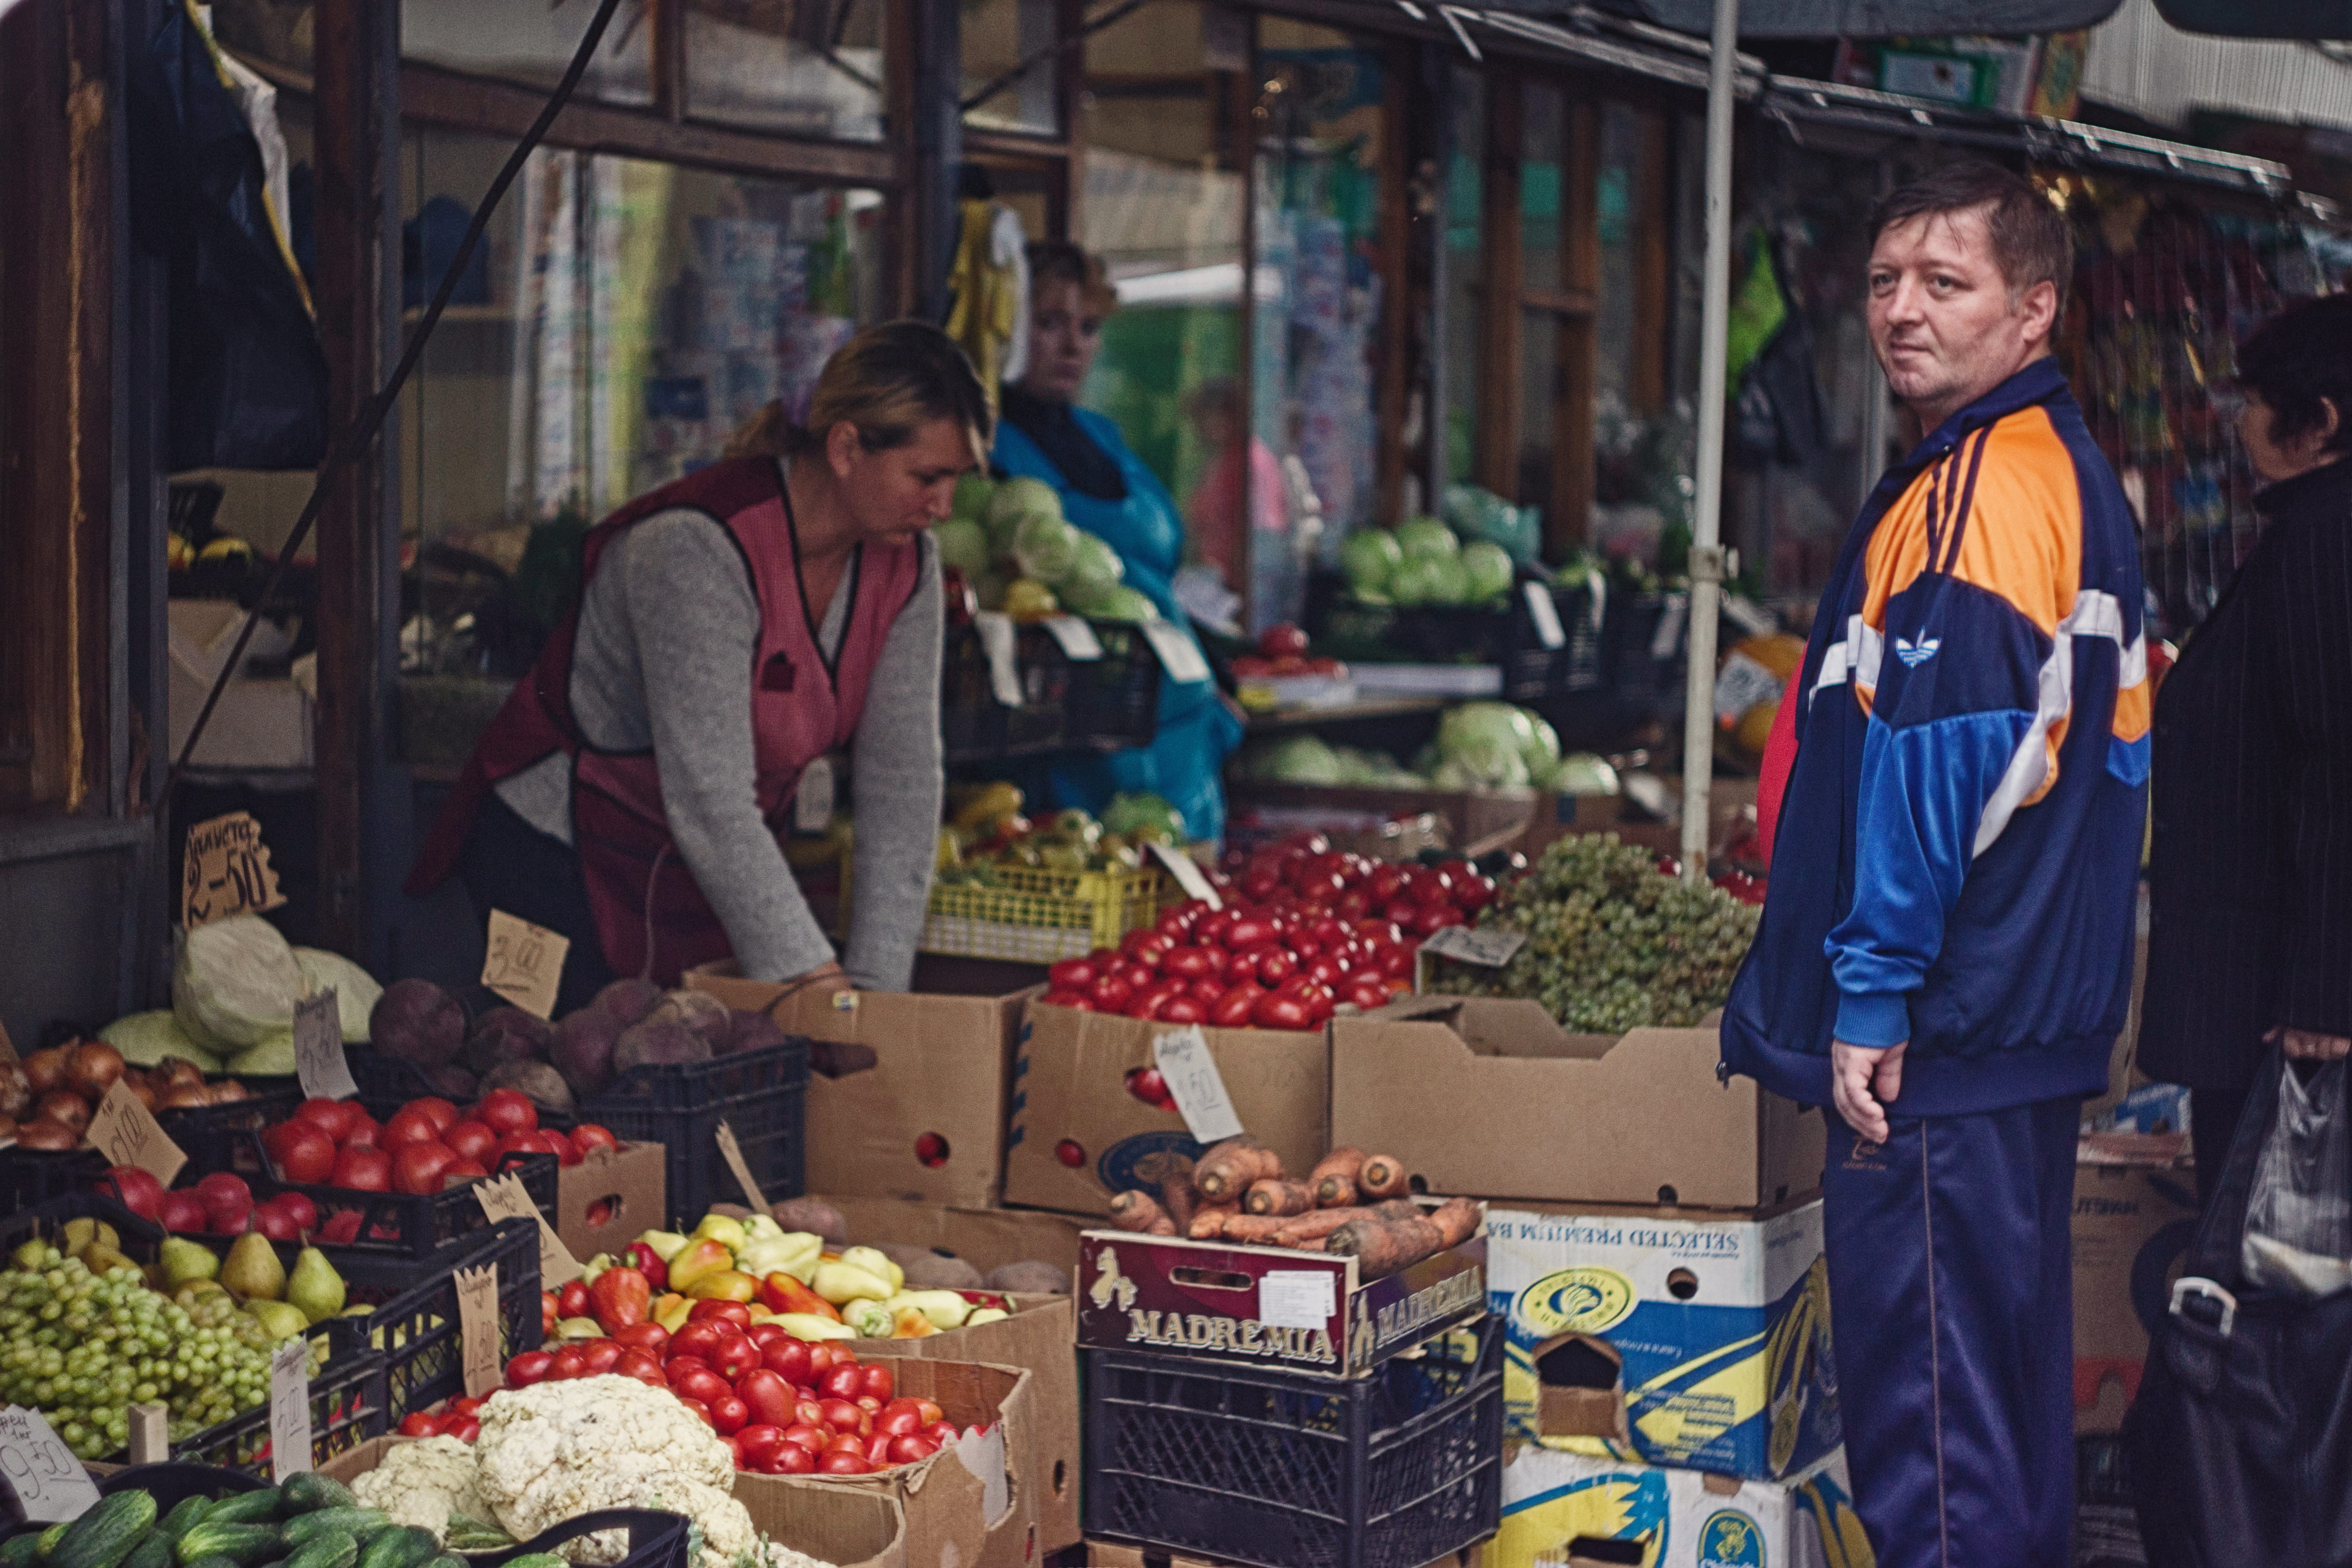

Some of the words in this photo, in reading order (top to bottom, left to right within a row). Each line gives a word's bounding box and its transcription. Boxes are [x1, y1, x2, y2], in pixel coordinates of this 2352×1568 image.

[1520, 1223, 1622, 1245] PREMIUM
[1629, 1229, 1740, 1252] SELECTED
[1126, 1308, 1337, 1365] MADREMIA
